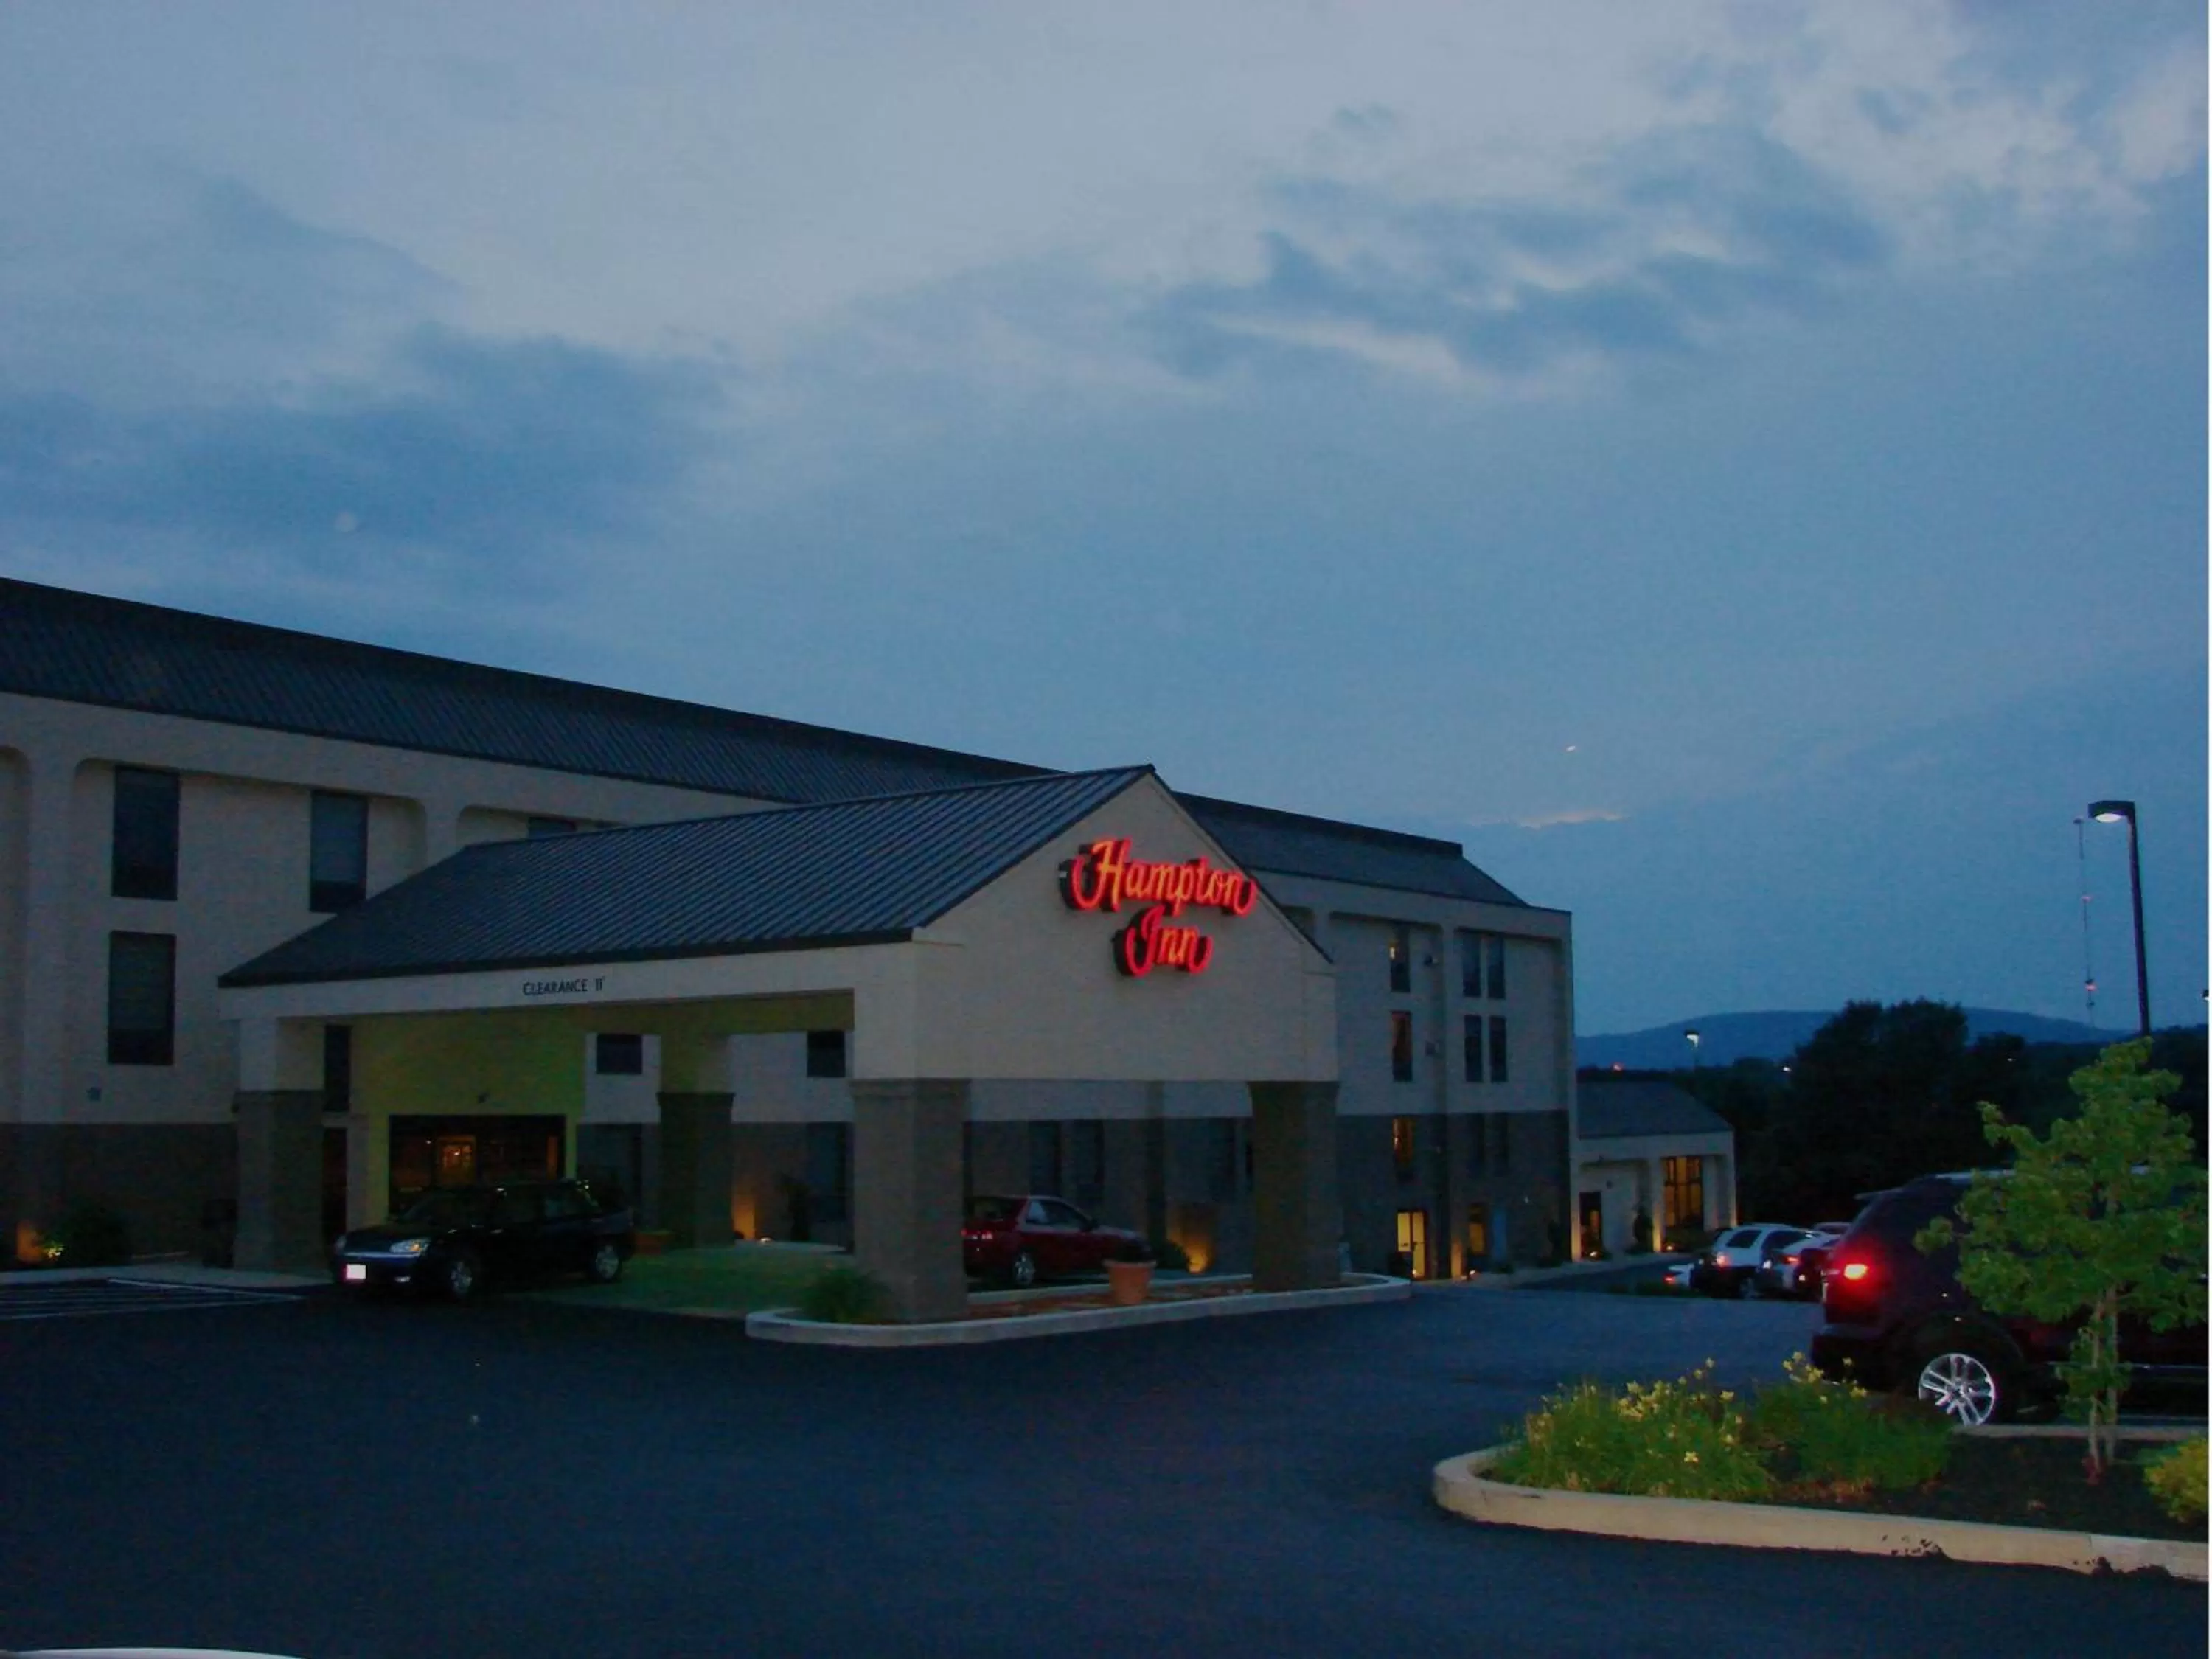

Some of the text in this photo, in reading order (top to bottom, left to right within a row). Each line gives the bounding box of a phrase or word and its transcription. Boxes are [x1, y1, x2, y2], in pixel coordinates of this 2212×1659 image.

[1069, 837, 1256, 917] Hampton
[1121, 902, 1214, 977] Inn
[523, 978, 588, 995] CLEARANCE
